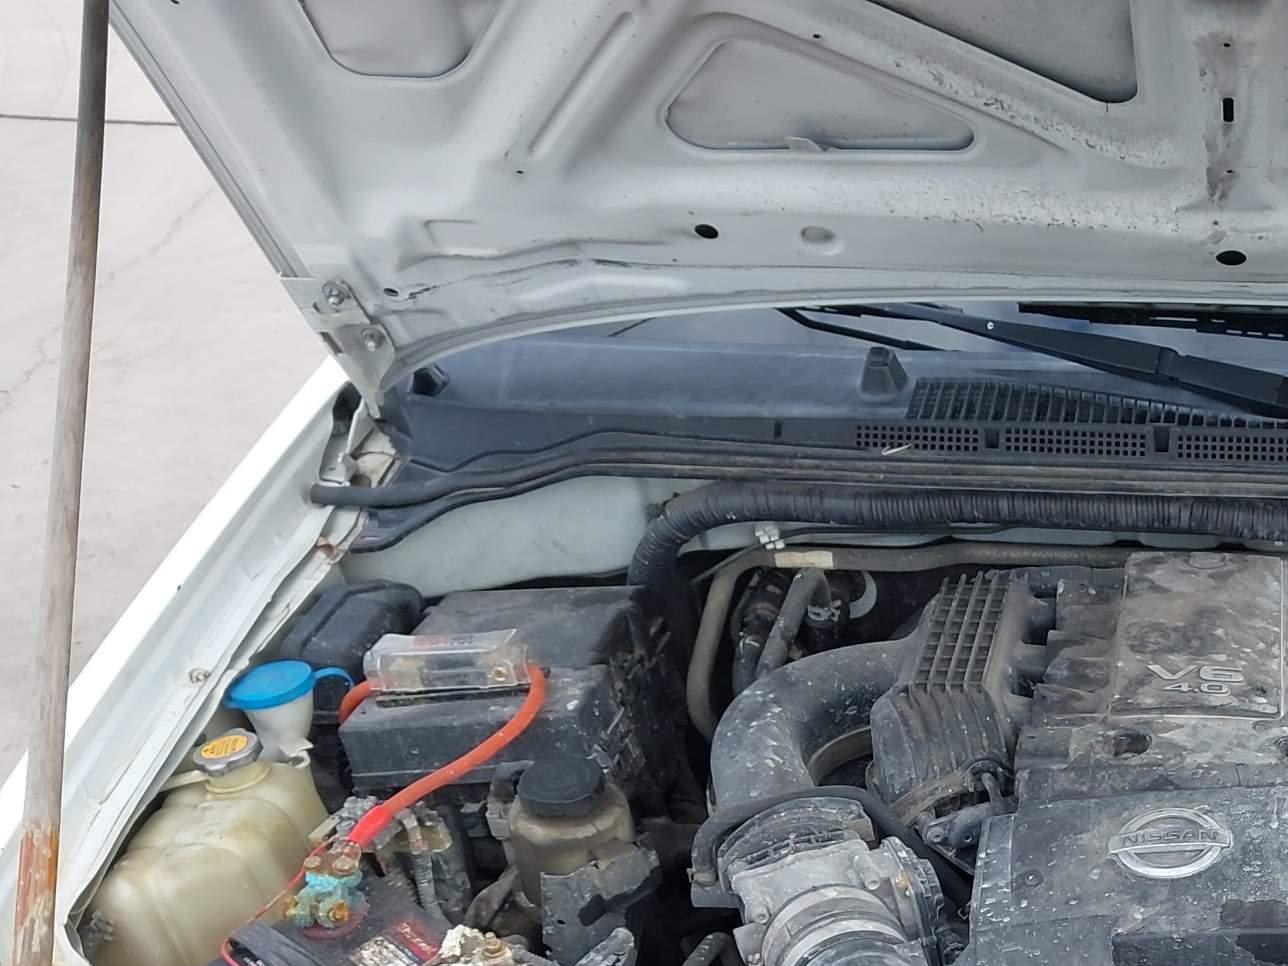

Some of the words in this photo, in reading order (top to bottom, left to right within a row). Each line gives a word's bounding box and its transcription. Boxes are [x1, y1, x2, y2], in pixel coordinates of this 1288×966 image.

[1146, 664, 1245, 683] V6
[1162, 682, 1231, 697] 4.0
[1121, 829, 1218, 846] NISSAN
